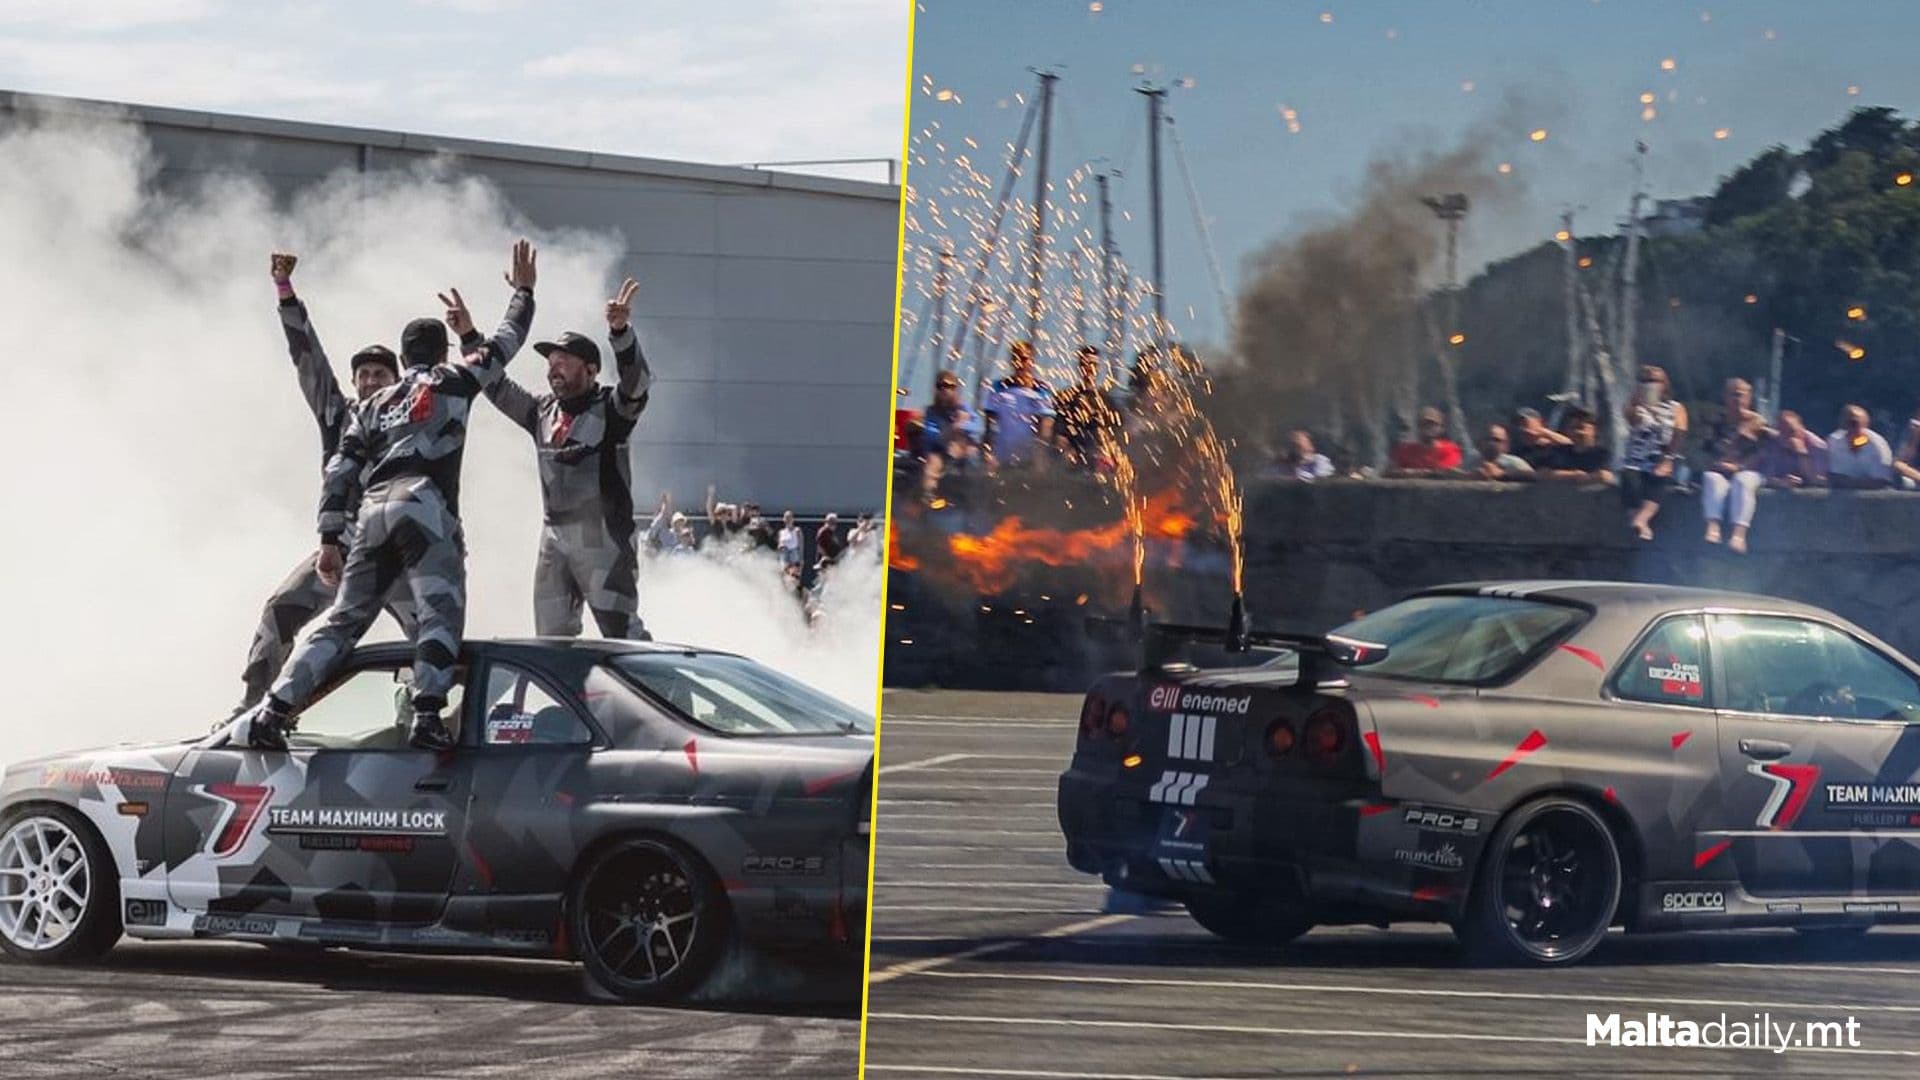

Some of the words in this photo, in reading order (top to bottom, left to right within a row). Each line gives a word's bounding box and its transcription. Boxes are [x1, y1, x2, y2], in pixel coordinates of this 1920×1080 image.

[1182, 693, 1252, 713] enemed
[1826, 785, 1868, 802] TEAM
[1871, 786, 1920, 802] MAXIM
[271, 809, 314, 824] TEAM
[318, 809, 398, 827] MAXIMUM
[402, 812, 446, 828] LOCK
[1406, 810, 1479, 830] PRO-S
[1663, 891, 1724, 907] sparco
[210, 918, 275, 932] MOLTON
